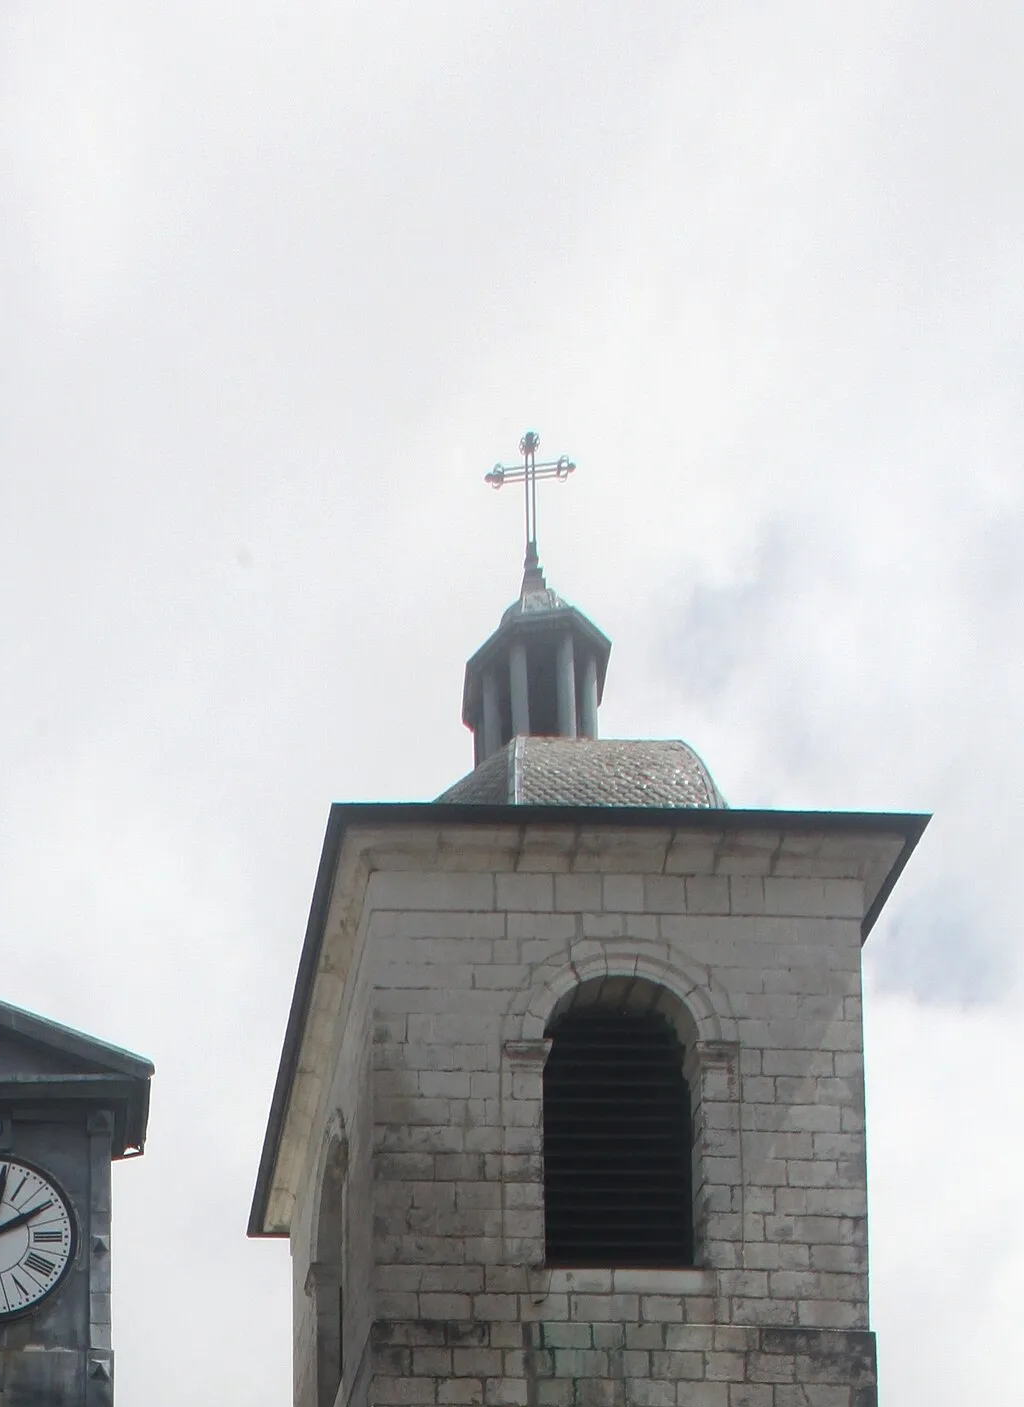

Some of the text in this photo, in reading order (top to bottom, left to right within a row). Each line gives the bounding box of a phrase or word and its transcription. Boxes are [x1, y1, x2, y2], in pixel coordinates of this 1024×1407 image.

[10, 1177, 28, 1202] I
[33, 1231, 63, 1243] III
[11, 1273, 29, 1300] V
